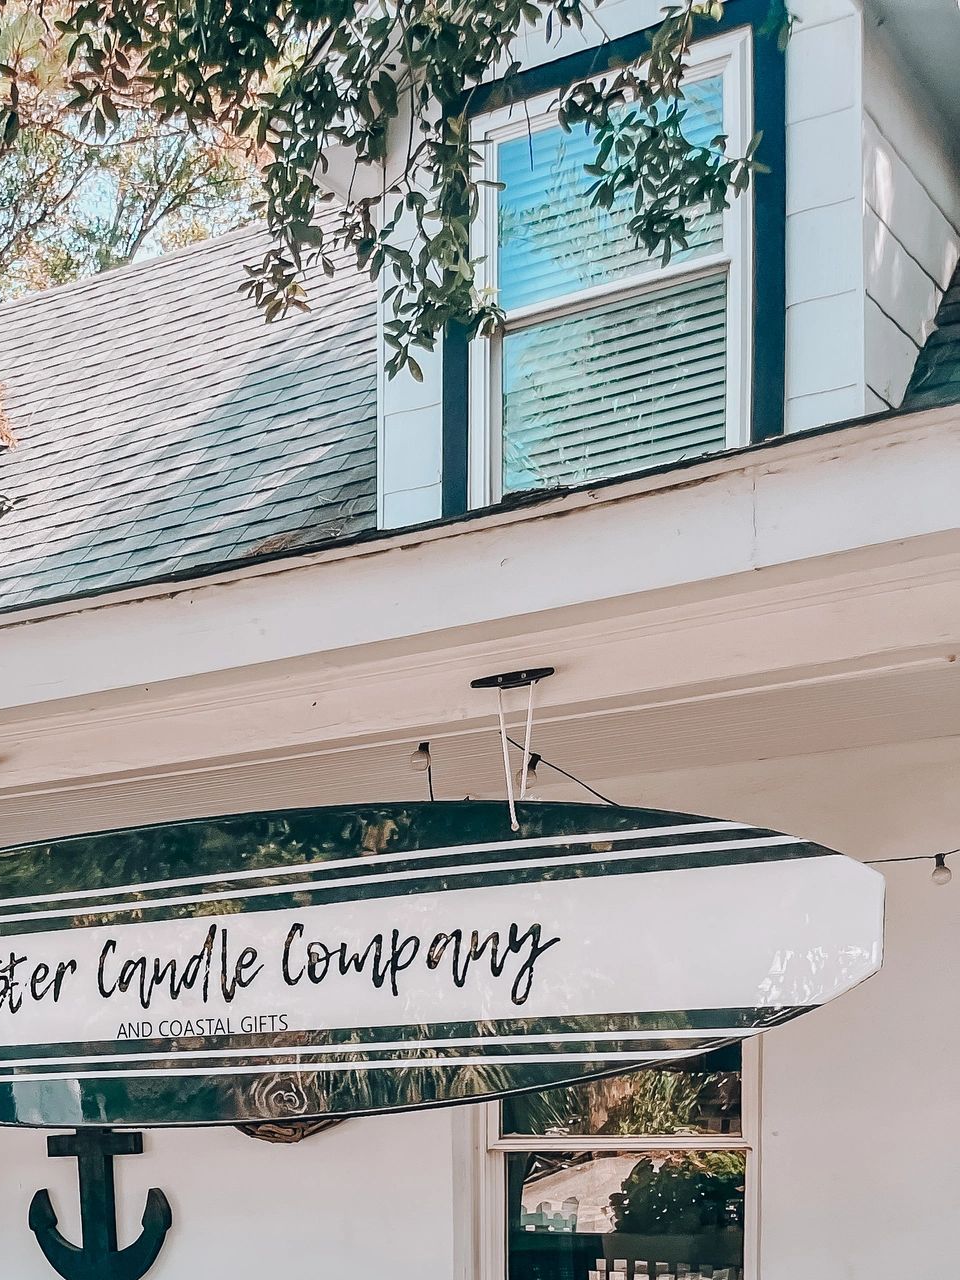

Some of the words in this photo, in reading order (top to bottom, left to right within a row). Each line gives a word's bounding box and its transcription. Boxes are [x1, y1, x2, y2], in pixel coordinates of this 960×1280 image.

[97, 923, 265, 1010] Candle
[281, 922, 561, 1006] Company
[116, 1022, 153, 1039] AND
[158, 1018, 235, 1037] COASTAL
[240, 1013, 289, 1034] GIFTS
